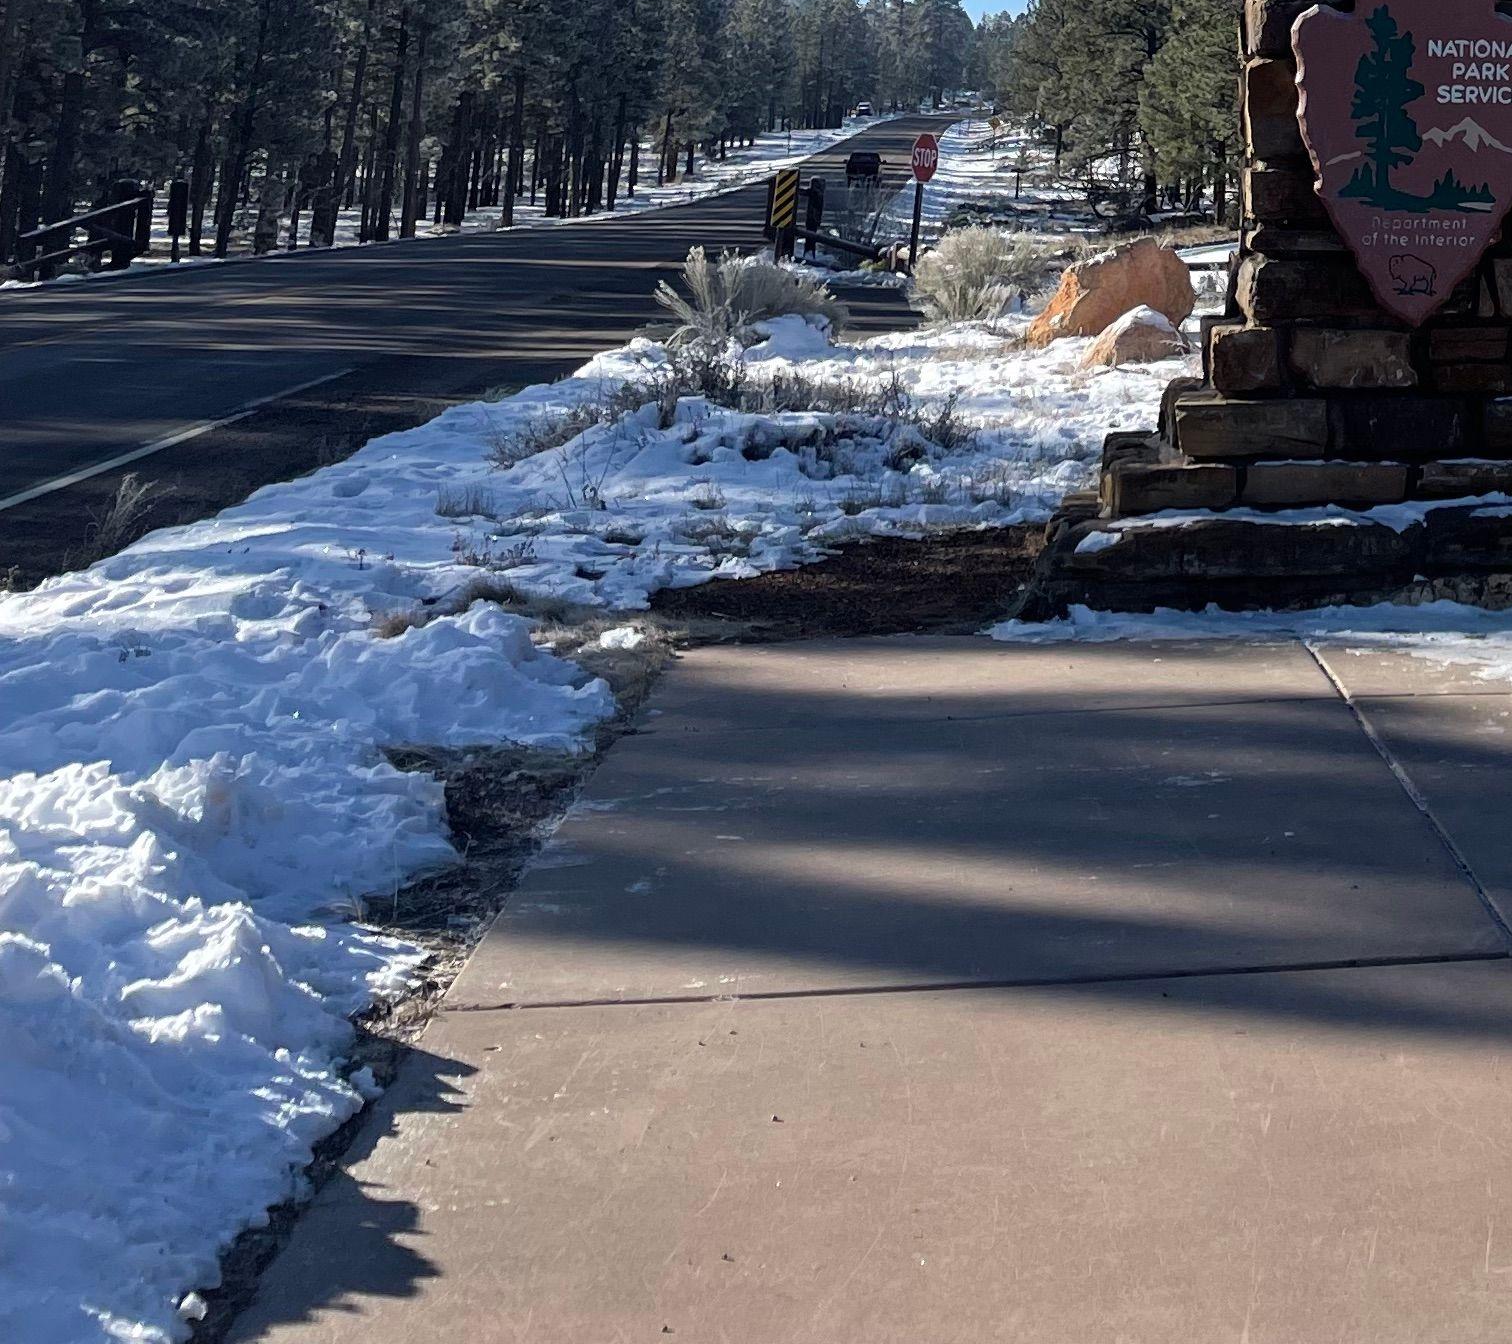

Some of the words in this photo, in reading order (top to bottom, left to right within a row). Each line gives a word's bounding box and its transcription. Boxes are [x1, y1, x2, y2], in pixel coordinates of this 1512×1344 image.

[1452, 62, 1511, 82] PARK
[913, 147, 937, 168] STOP
[1361, 231, 1379, 247] of
[1383, 233, 1409, 247] the
[1415, 233, 1476, 247] Interior
